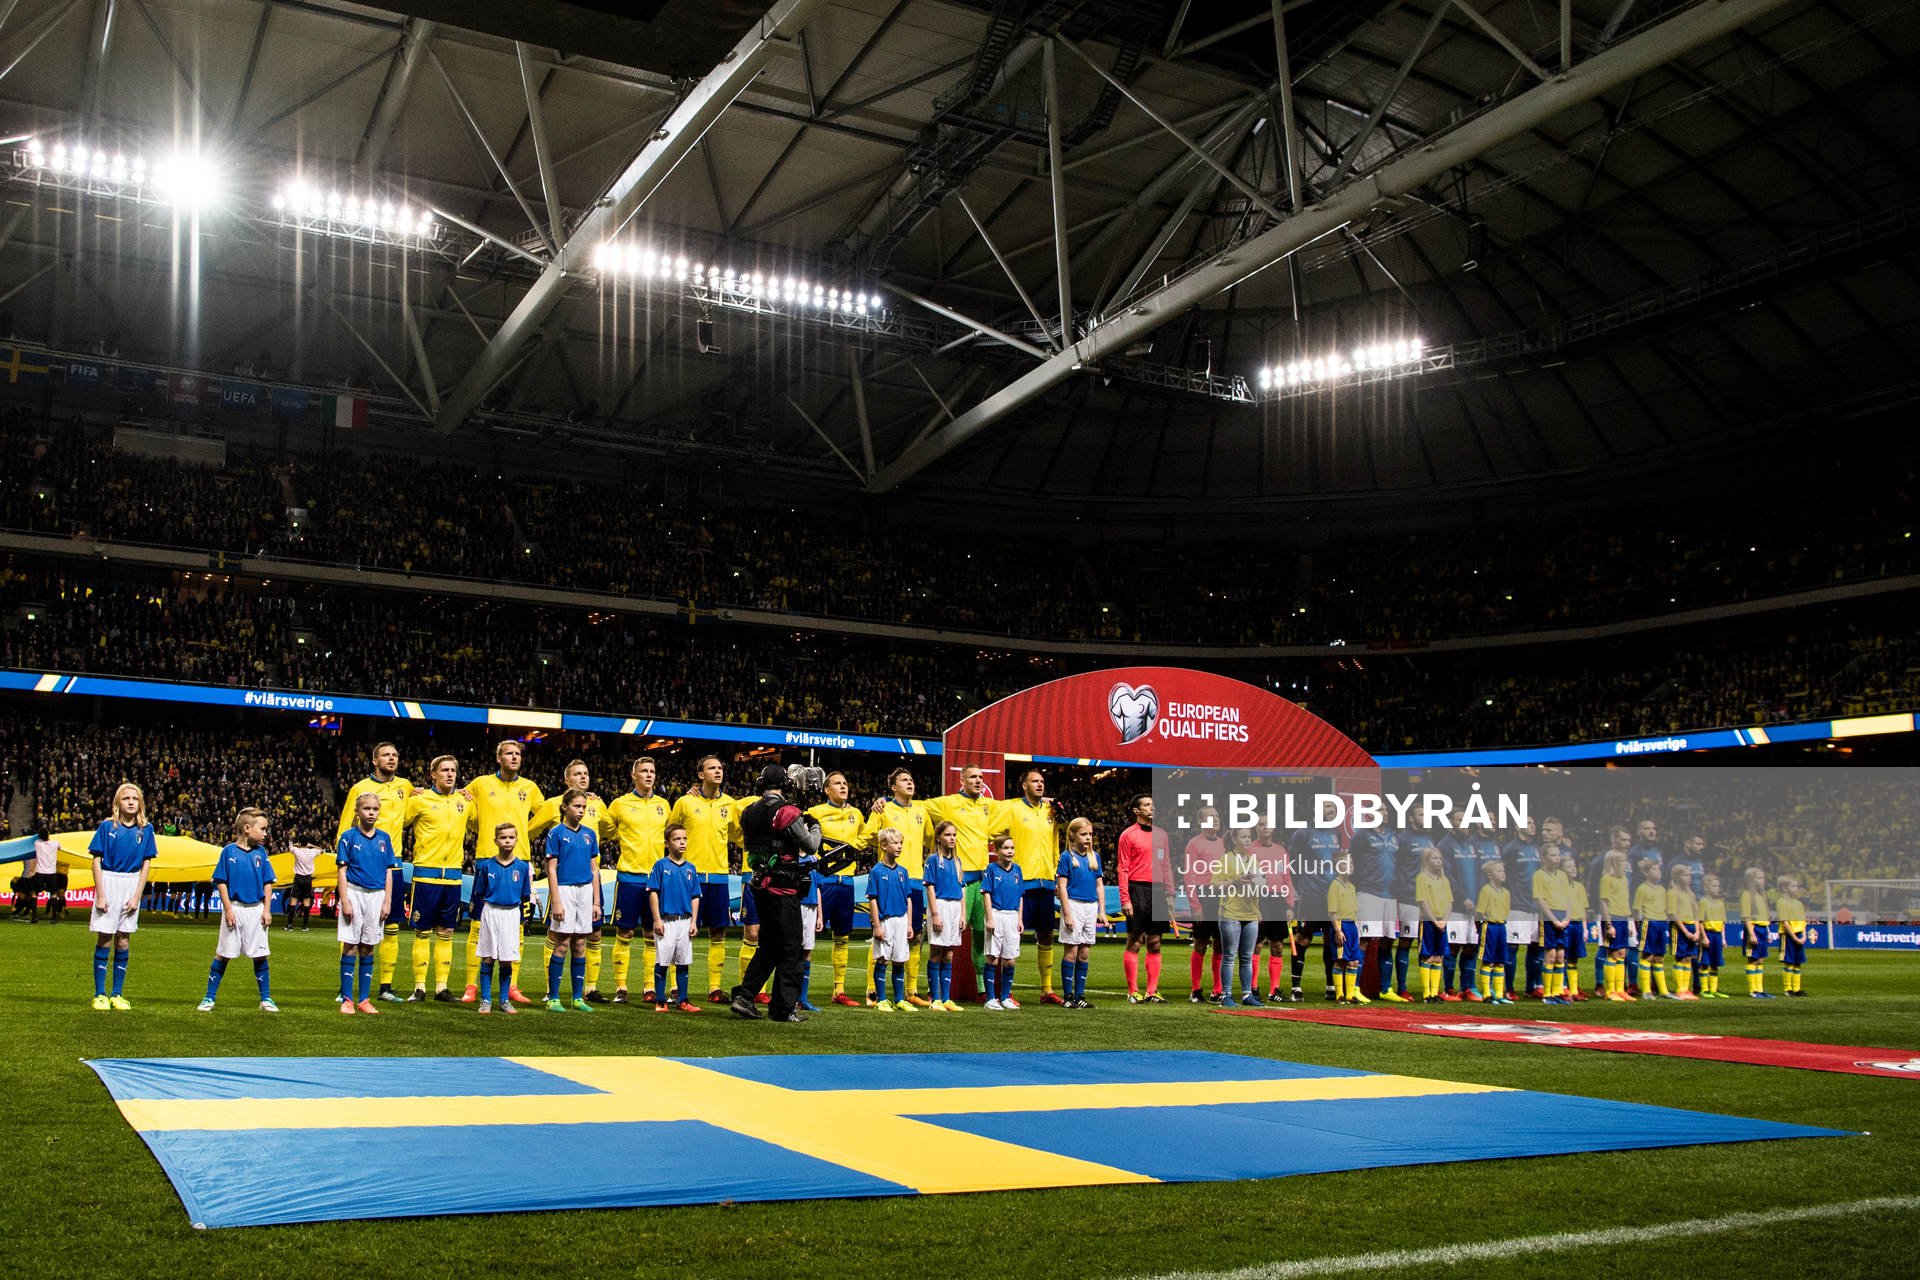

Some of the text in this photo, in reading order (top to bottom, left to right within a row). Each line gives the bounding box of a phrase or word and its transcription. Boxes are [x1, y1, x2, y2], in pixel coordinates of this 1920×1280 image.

[71, 364, 98, 377] FIFA
[223, 391, 256, 405] UEFA
[244, 691, 334, 712] #viärsverige
[1168, 702, 1240, 722] EUROPEAN
[1159, 718, 1249, 743] QUALIFIERS
[65, 890, 96, 902] QUAL
[1857, 931, 1920, 946] #viärsverig
